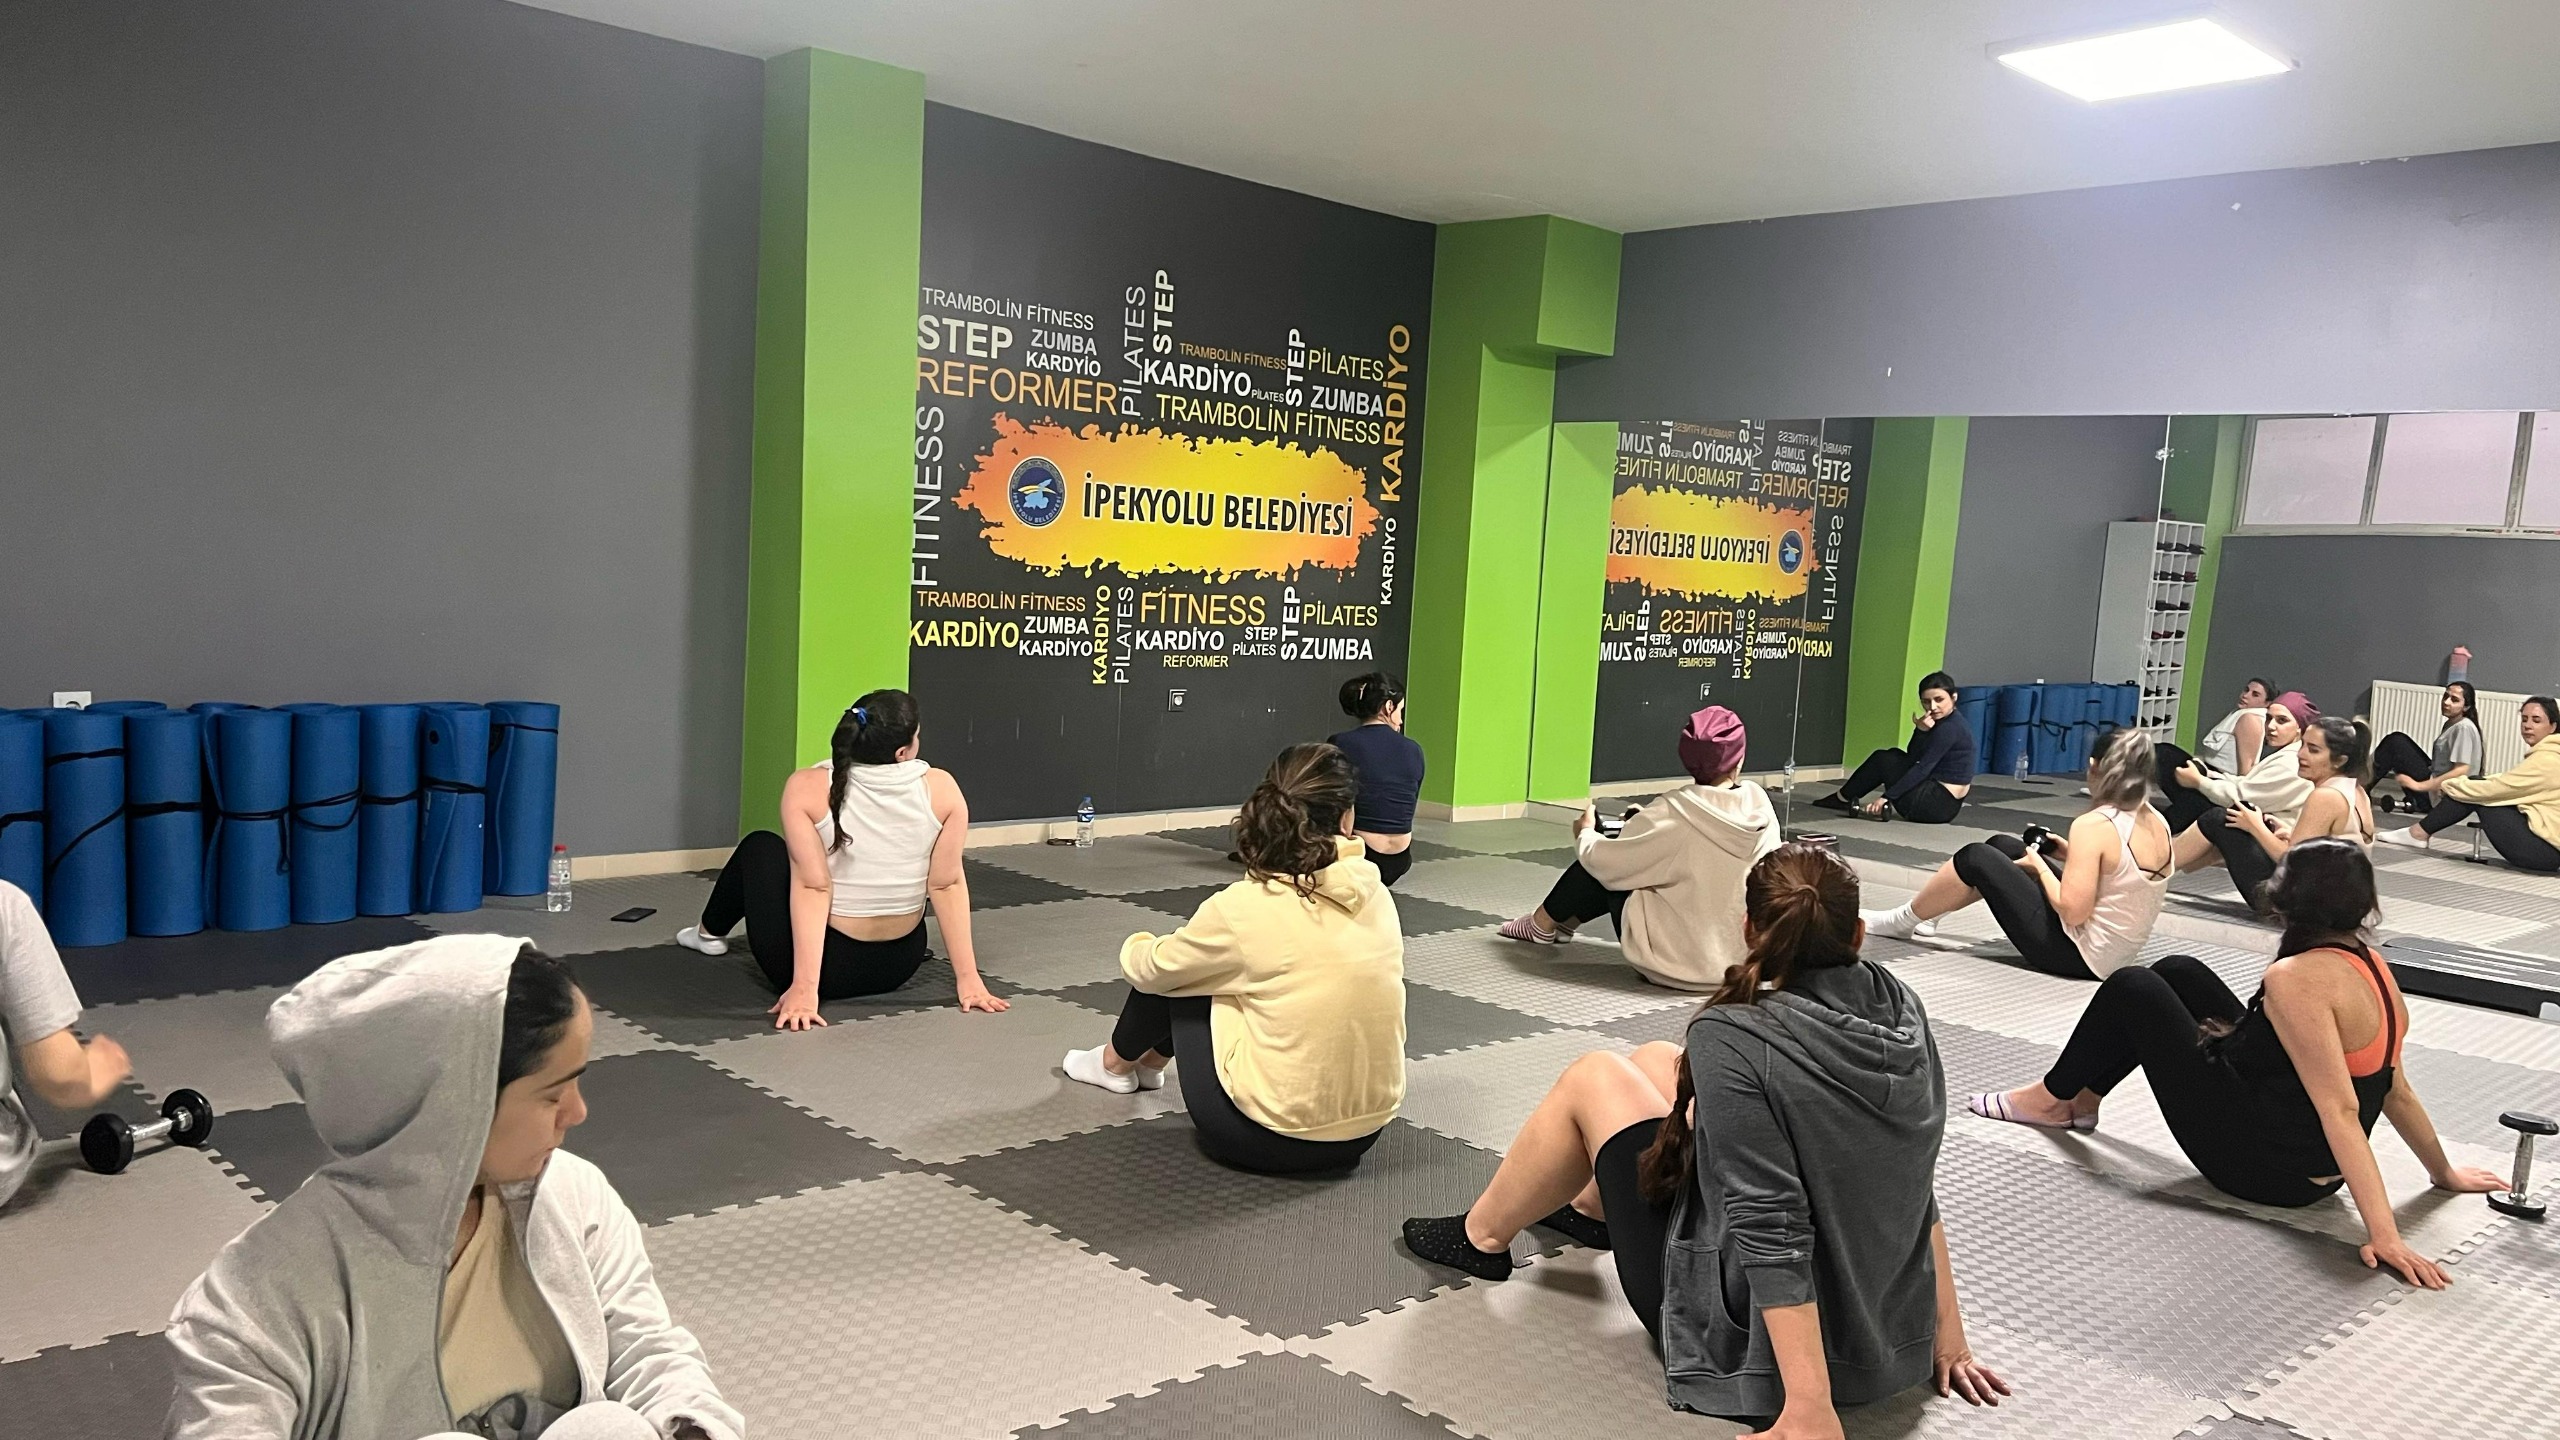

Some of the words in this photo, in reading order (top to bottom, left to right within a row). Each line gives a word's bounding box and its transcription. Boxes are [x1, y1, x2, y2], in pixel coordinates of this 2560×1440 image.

[922, 287, 1022, 319] TRAMBOLİN
[1027, 303, 1094, 331] FİTNESS
[1153, 269, 1174, 355] STEP
[917, 314, 1013, 359] STEP
[1031, 328, 1097, 356] ZUMBA
[1119, 286, 1146, 417] PİLATES
[1026, 350, 1101, 377] KARDYİO
[1179, 342, 1242, 364] TRAMBOLİN
[1244, 350, 1287, 371] FİTNESS
[1286, 328, 1306, 407] STEP
[1308, 347, 1384, 382] PİLATES
[916, 356, 1118, 416] REFORMER
[1143, 358, 1252, 397] KARDİYO
[1251, 387, 1285, 403] PİLATES
[1156, 393, 1288, 434] TRAMBOLİN
[1295, 409, 1381, 445] FİTNESS
[1310, 385, 1384, 418] ZUMBA
[1380, 324, 1411, 502] KARDİYO
[1083, 471, 1215, 527] İPEKYOLU
[1223, 491, 1353, 537] BELEDİYESİ
[1380, 517, 1398, 605] KARDİYO
[917, 590, 1016, 610] TRAMBOLİN
[1020, 592, 1086, 613] FİTNESS
[1140, 586, 1266, 626] FİTNESS
[1303, 600, 1378, 627] PİLATES
[910, 616, 1020, 648] KARDİYO
[1023, 616, 1090, 635] ZUMBA
[1092, 585, 1111, 684] KARDİYO
[1111, 586, 1134, 684] PİLATES
[1135, 626, 1225, 652] KARDİYO
[1244, 626, 1278, 642] STEP
[1280, 585, 1301, 661] STEP
[1018, 637, 1093, 657] KARDİYO
[1163, 654, 1229, 668] REFORMER
[1232, 641, 1277, 656] PİLATES
[1300, 637, 1374, 661] ZUMBA
